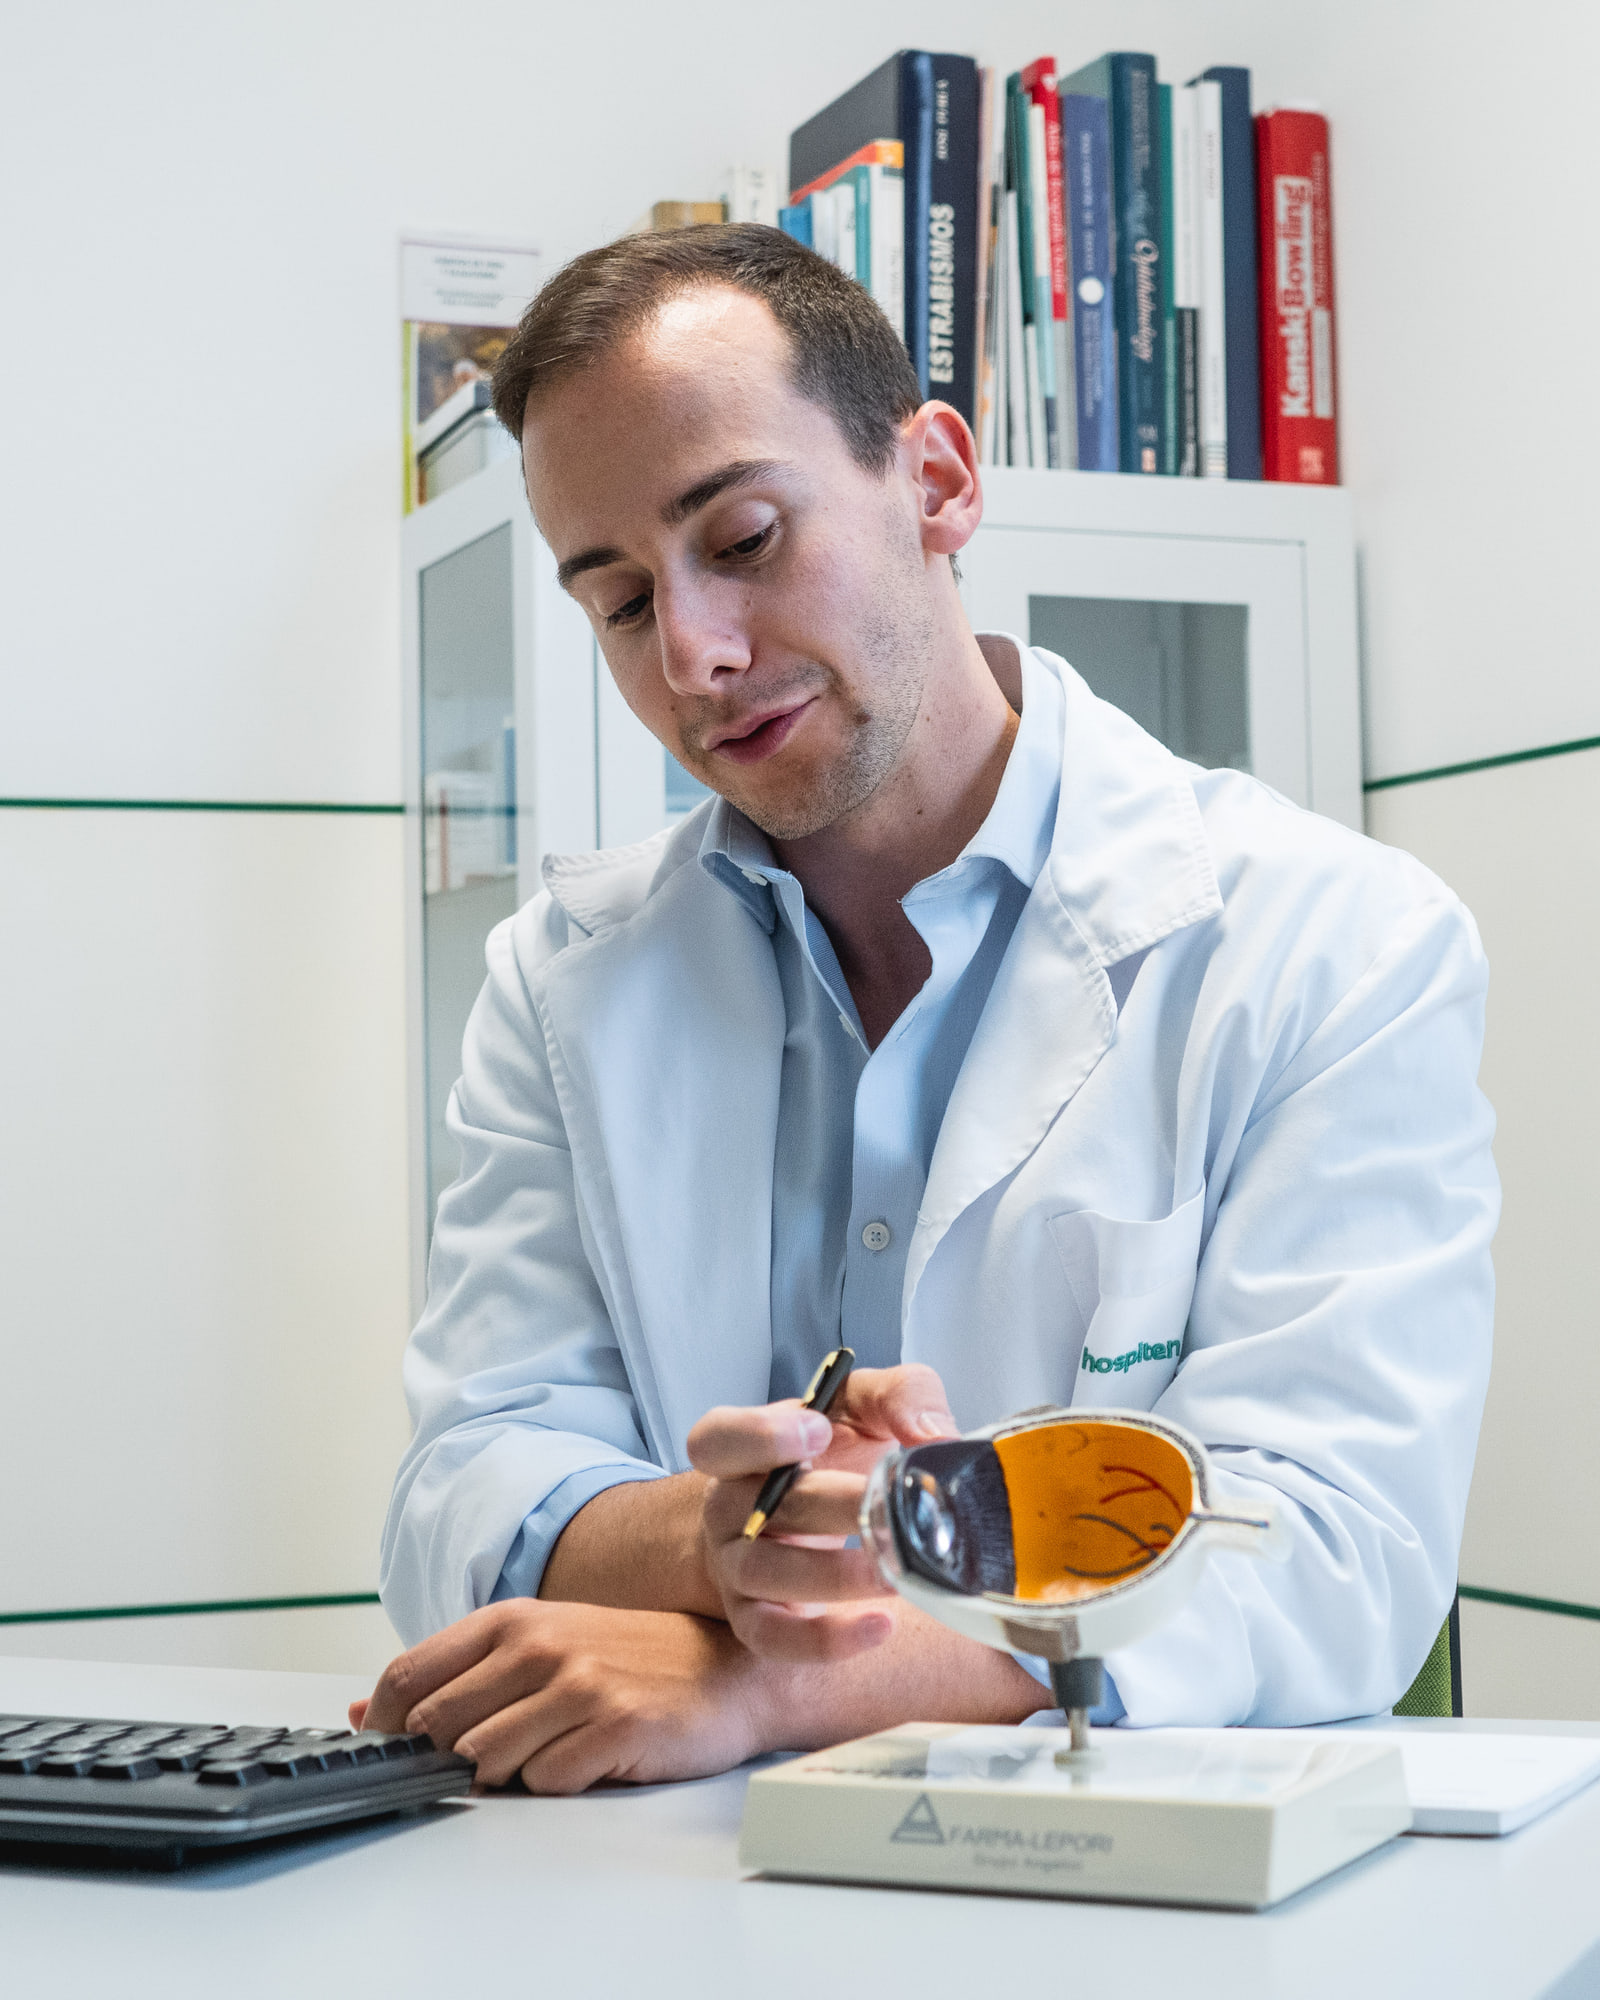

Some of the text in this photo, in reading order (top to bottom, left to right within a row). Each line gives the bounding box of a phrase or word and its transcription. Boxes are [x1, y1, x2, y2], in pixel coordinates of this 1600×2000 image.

[928, 203, 955, 384] ESTRABISMOS
[1081, 1339, 1181, 1374] hospiten
[948, 1824, 1114, 1855] FARMA-LEPORI
